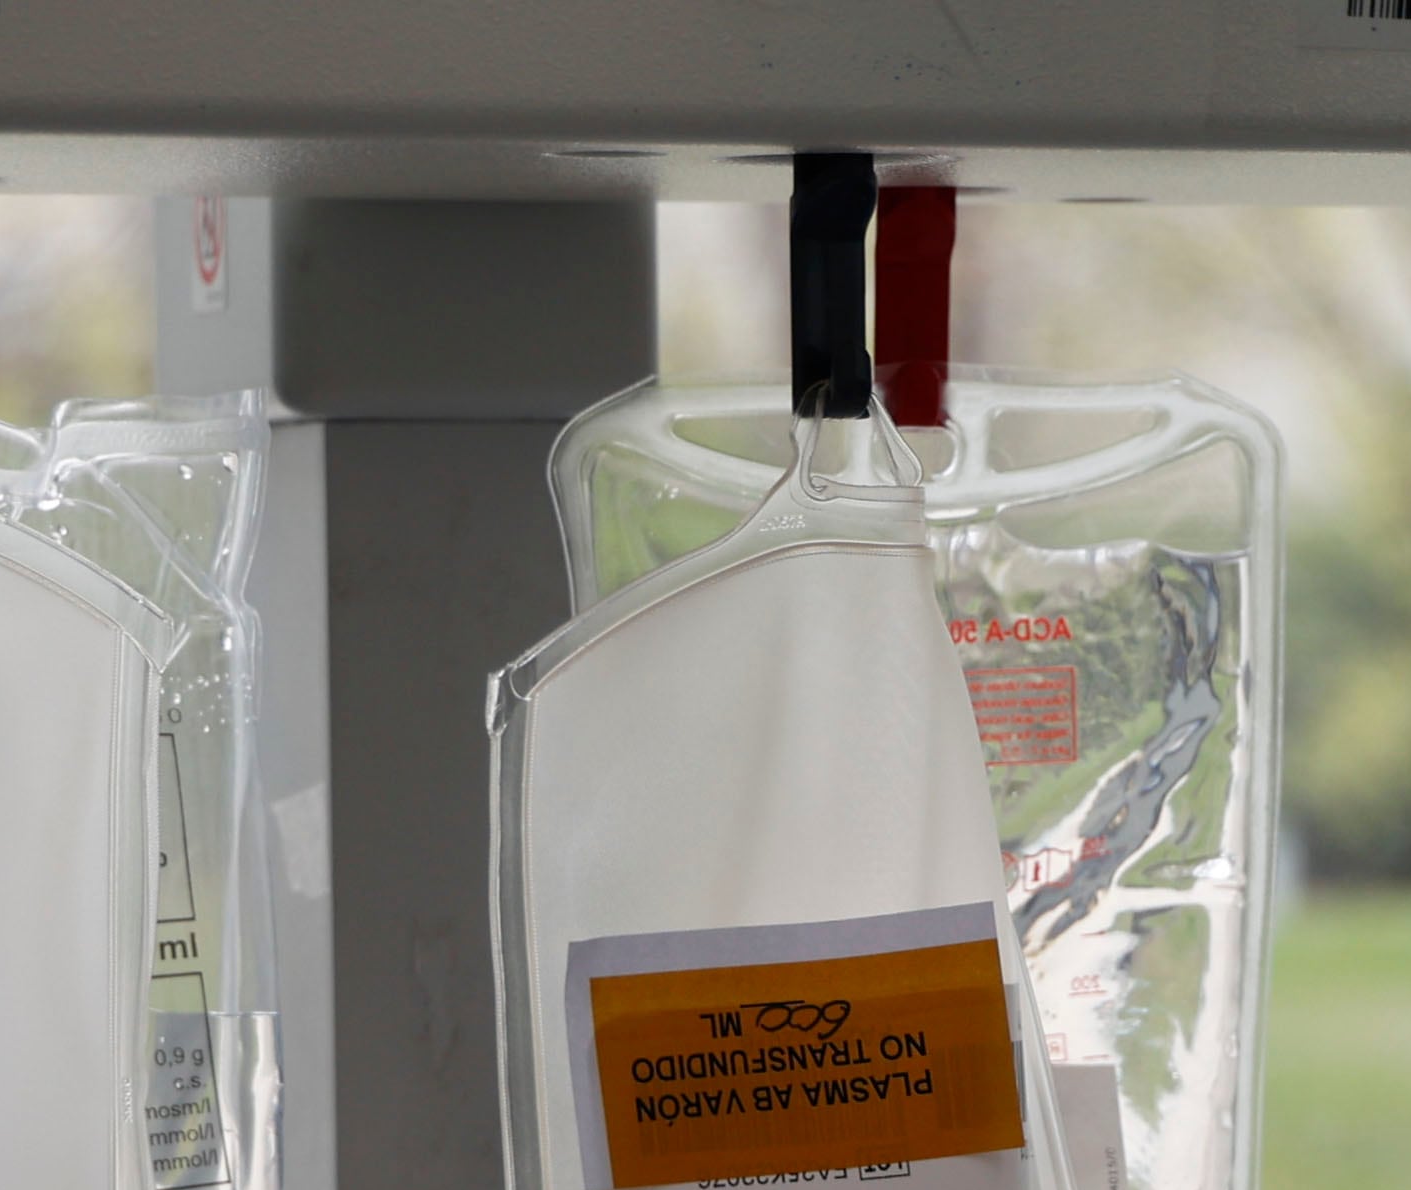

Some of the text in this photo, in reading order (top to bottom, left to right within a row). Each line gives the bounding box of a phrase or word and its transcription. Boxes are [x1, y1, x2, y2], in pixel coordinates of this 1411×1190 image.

[698, 1010, 743, 1039] ML
[154, 1046, 205, 1068] 0,9 g
[630, 1031, 927, 1084] NO TRANSFUNDIDO
[635, 1070, 934, 1128] PLASMA AB VARÓN
